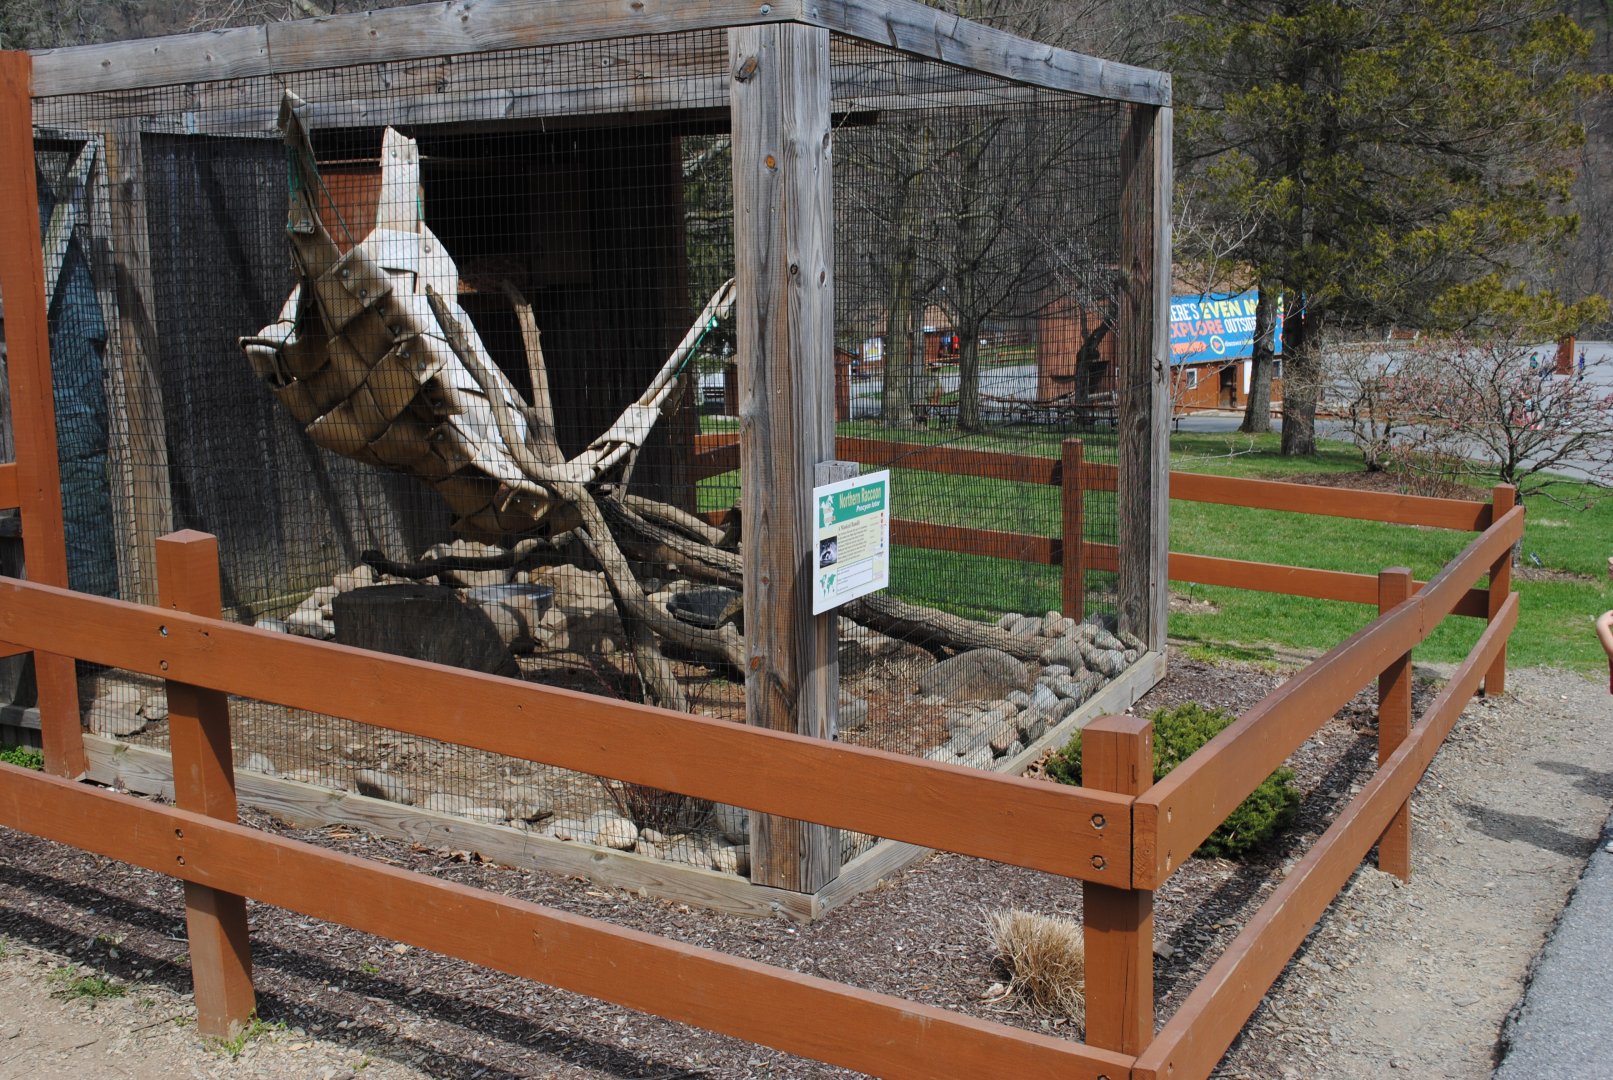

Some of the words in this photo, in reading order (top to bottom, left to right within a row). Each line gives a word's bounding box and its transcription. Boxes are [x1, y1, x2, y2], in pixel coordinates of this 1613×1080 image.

[1170, 303, 1200, 322] ERE'S
[1199, 300, 1242, 319] EVEN
[839, 491, 861, 509] Northern
[861, 487, 881, 503] Raccoon
